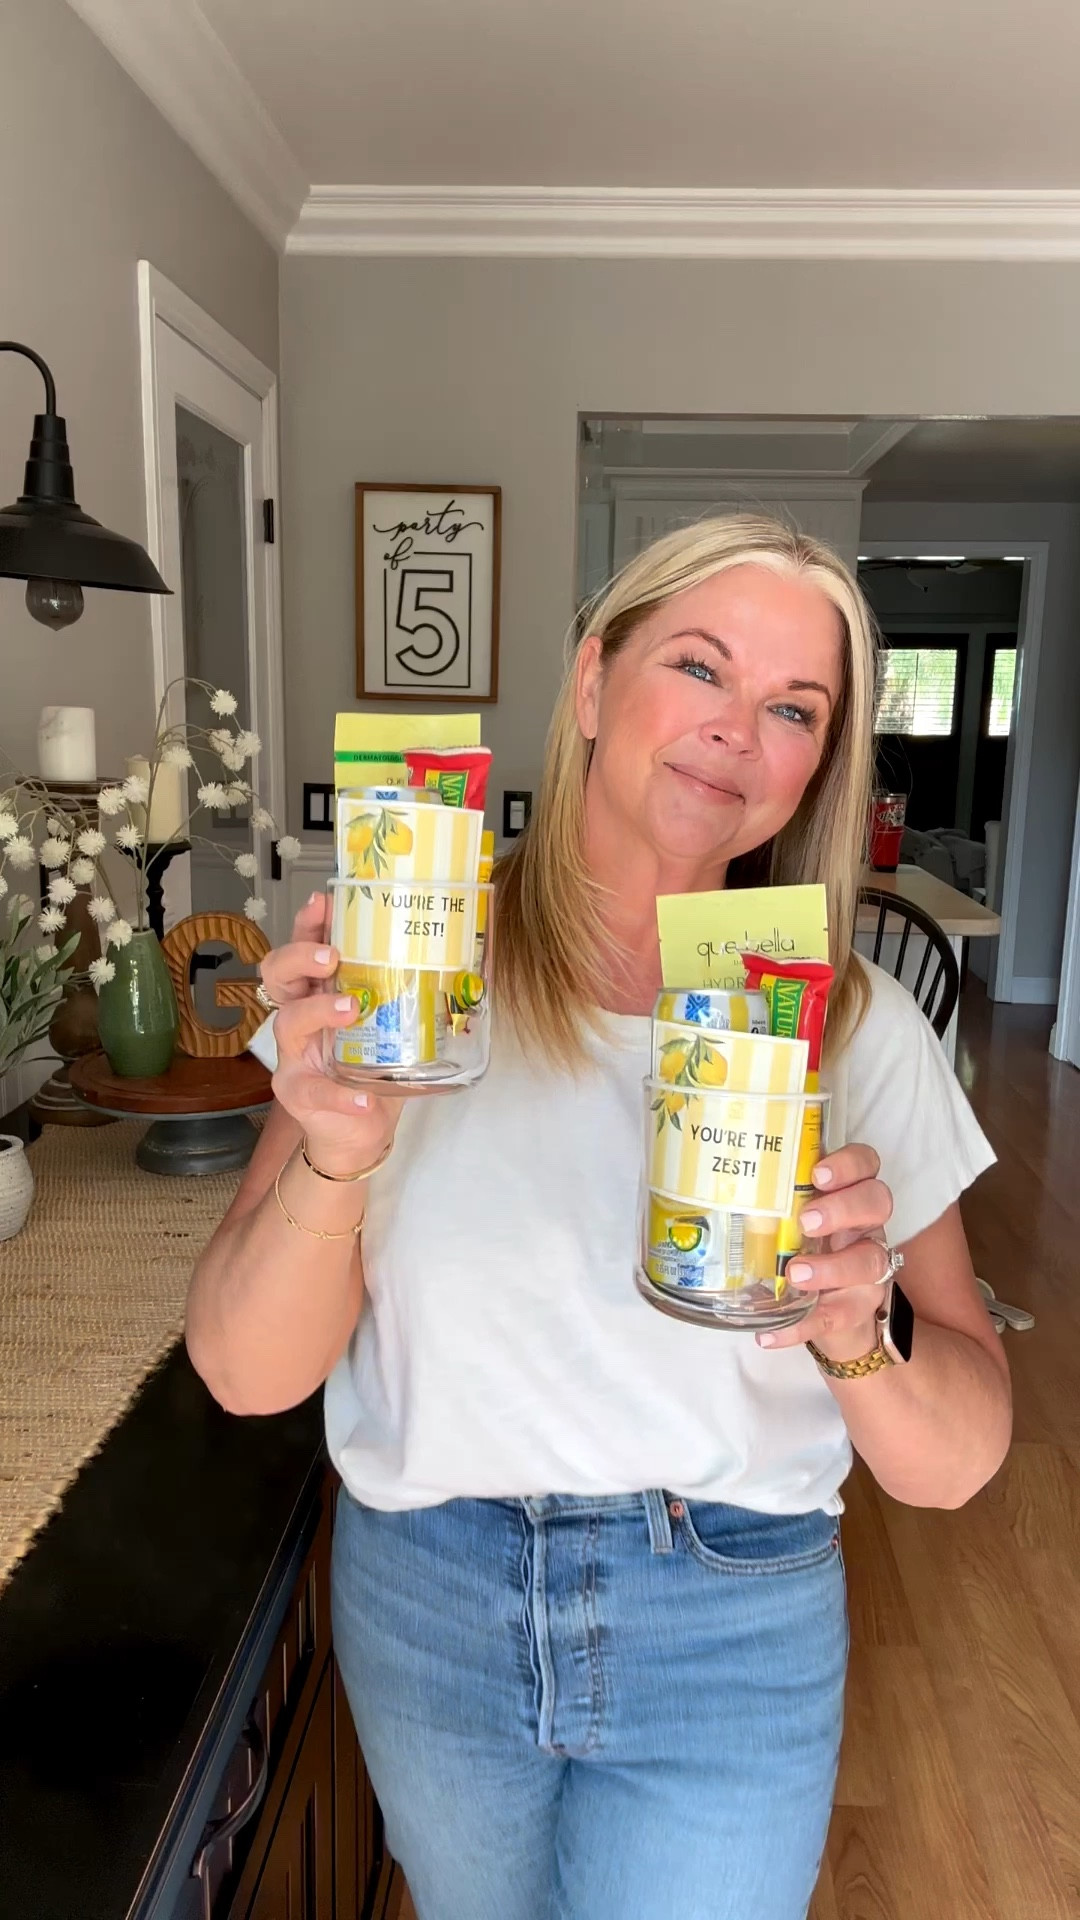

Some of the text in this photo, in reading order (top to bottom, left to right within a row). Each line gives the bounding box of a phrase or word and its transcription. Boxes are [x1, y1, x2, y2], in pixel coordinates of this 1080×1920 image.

[373, 499, 485, 543] party
[383, 536, 414, 571] of
[395, 568, 460, 677] 5
[381, 892, 466, 914] YOU'RE THE
[403, 920, 445, 937] ZEST!
[696, 940, 738, 968] que
[690, 1123, 784, 1153] YOU'RE THE
[711, 1155, 757, 1178] ZEST!
